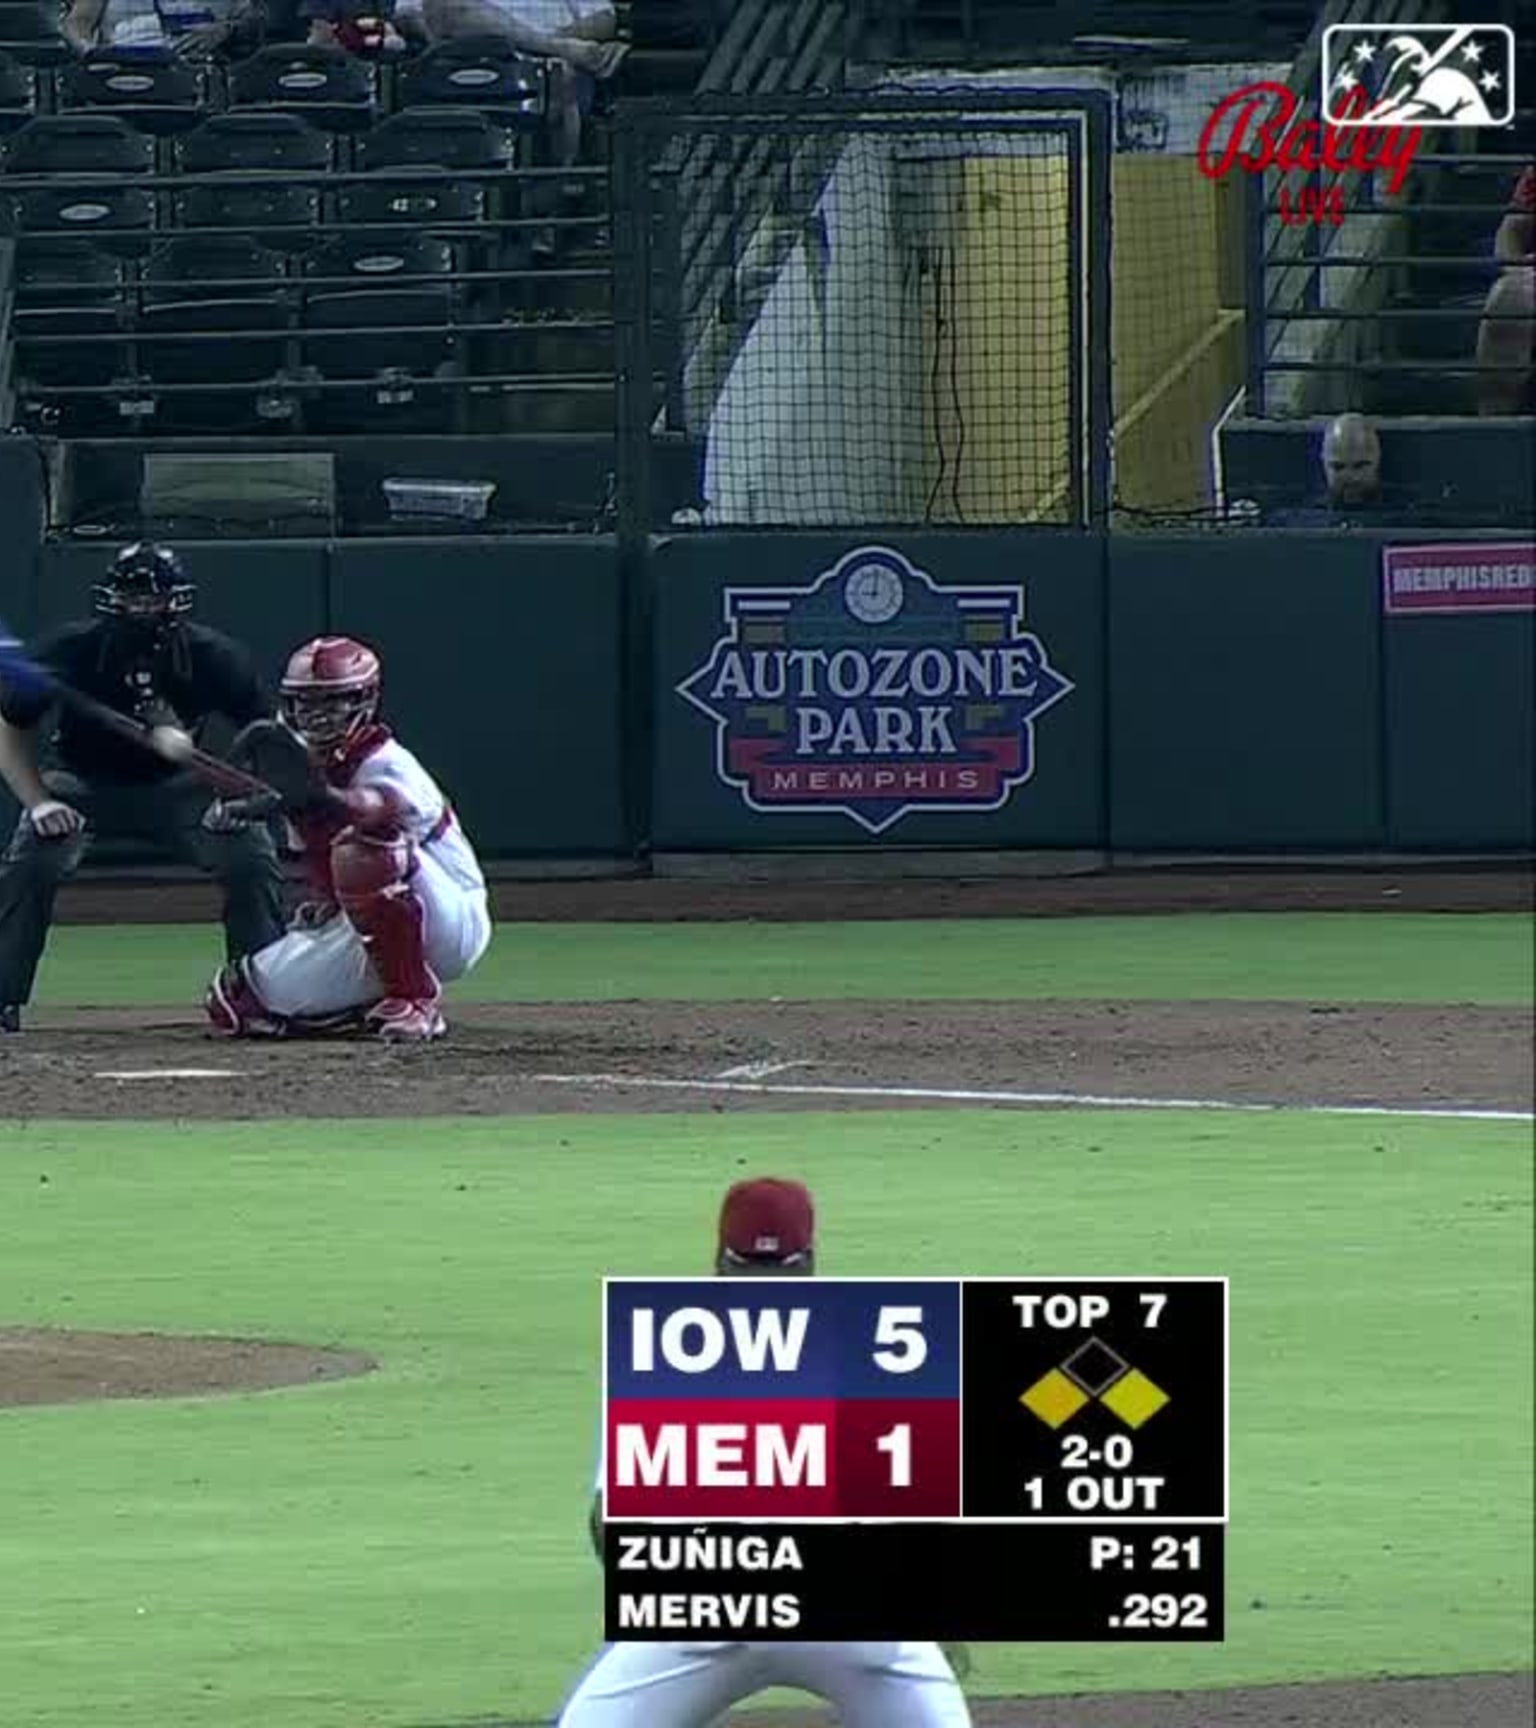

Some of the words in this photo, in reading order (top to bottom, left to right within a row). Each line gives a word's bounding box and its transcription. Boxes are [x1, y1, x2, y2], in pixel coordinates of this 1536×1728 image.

[710, 648, 1038, 699] AUTOZONE
[796, 706, 957, 755] PARK
[774, 770, 980, 790] MEMPHIS
